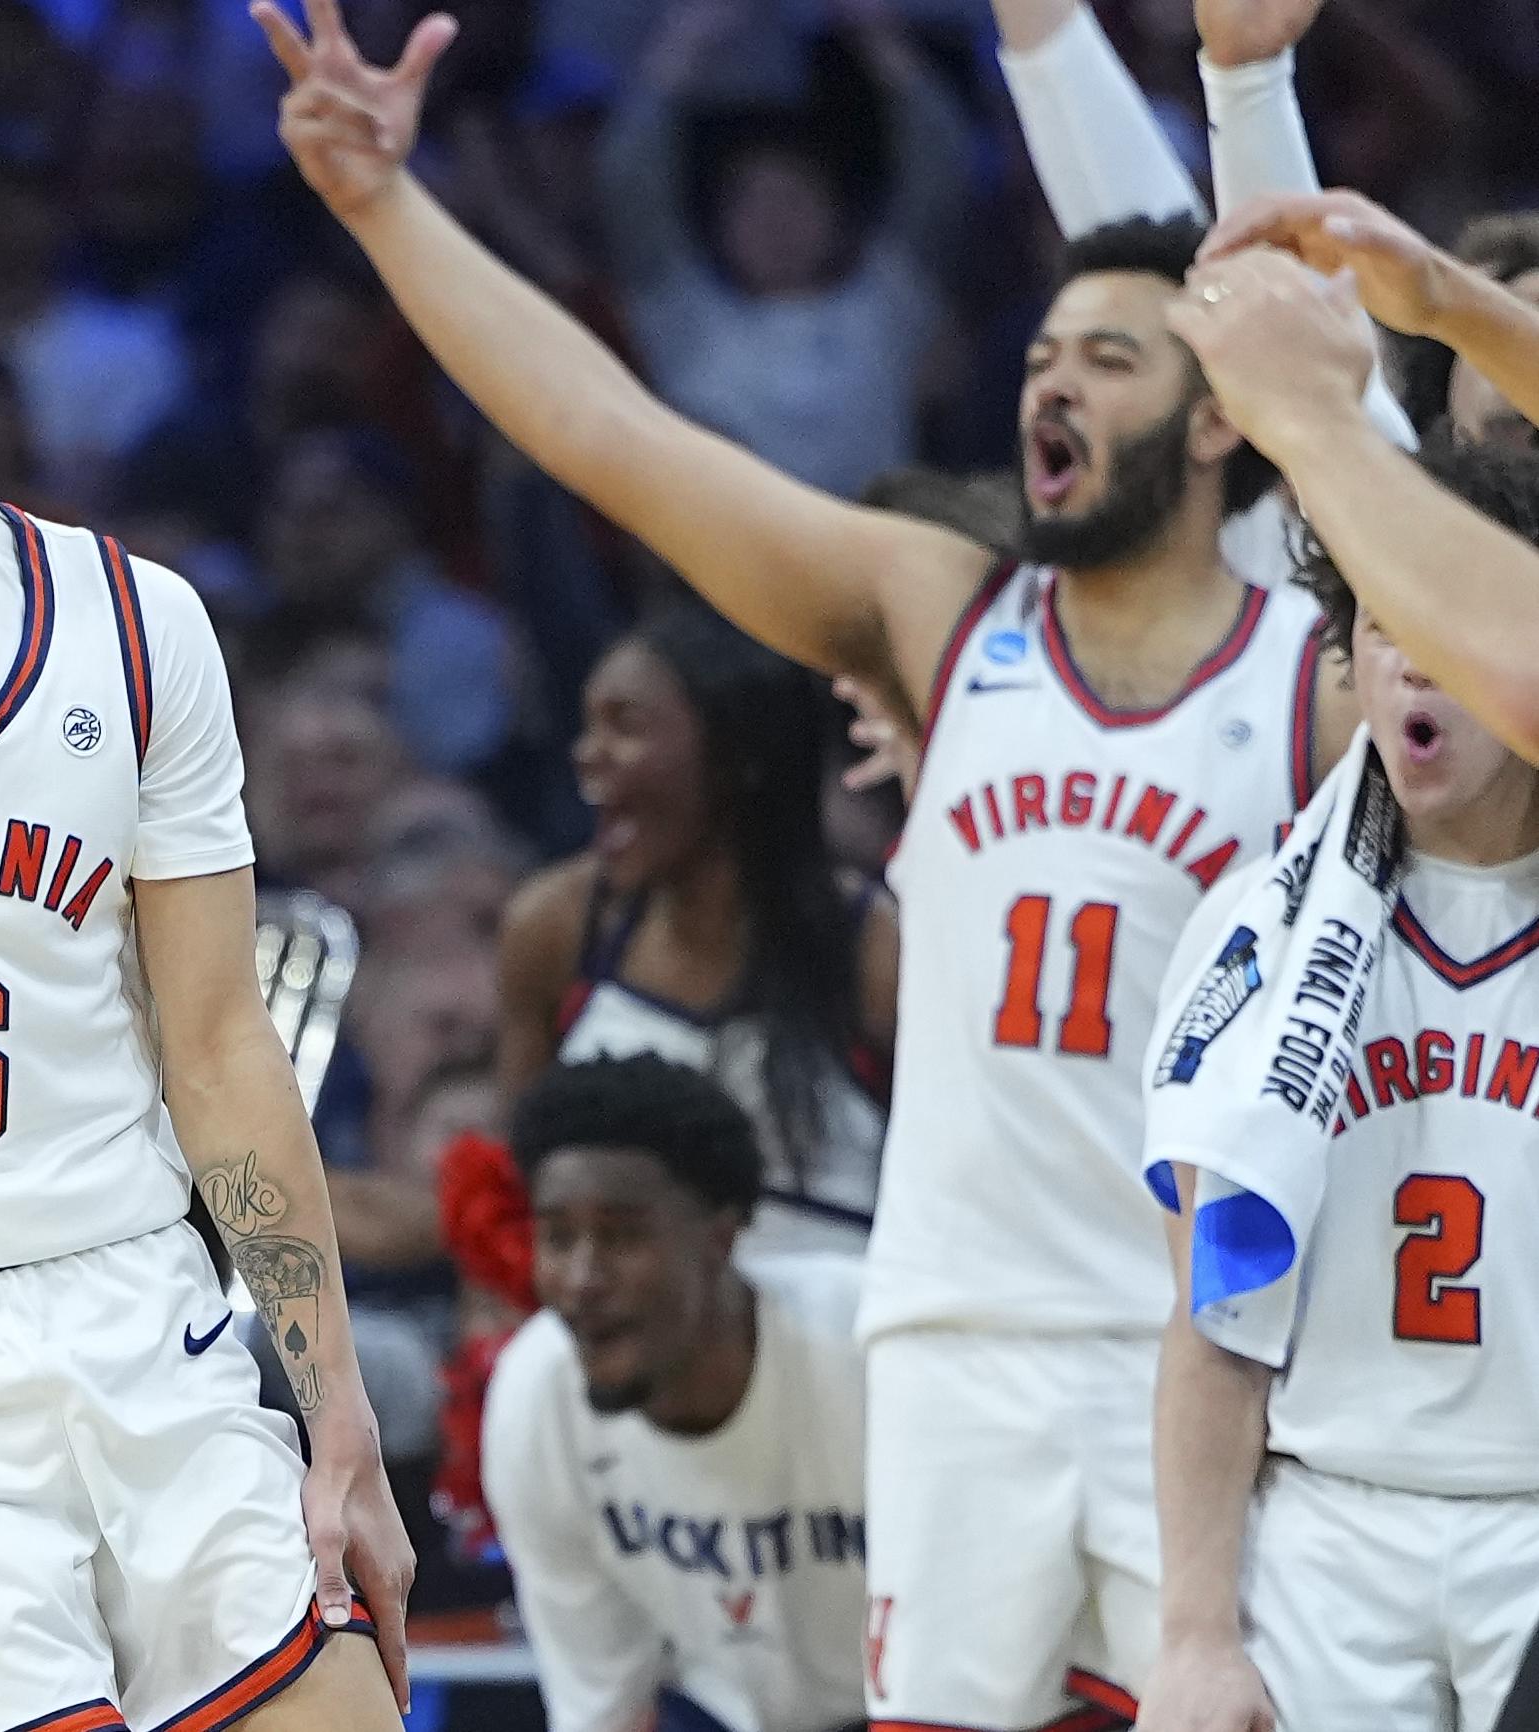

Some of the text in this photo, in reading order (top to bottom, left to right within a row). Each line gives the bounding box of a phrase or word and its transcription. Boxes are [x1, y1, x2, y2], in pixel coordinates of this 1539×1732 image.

[67, 719, 98, 736] ACC
[948, 770, 1240, 894] VIRGINIA
[993, 894, 1119, 1057] 11
[1260, 918, 1363, 1112] FINAL FOUR
[1309, 1080, 1338, 1133] THE
[1330, 1045, 1351, 1081] TO
[1332, 1029, 1539, 1138] IRGIN
[1393, 1171, 1485, 1346] 2
